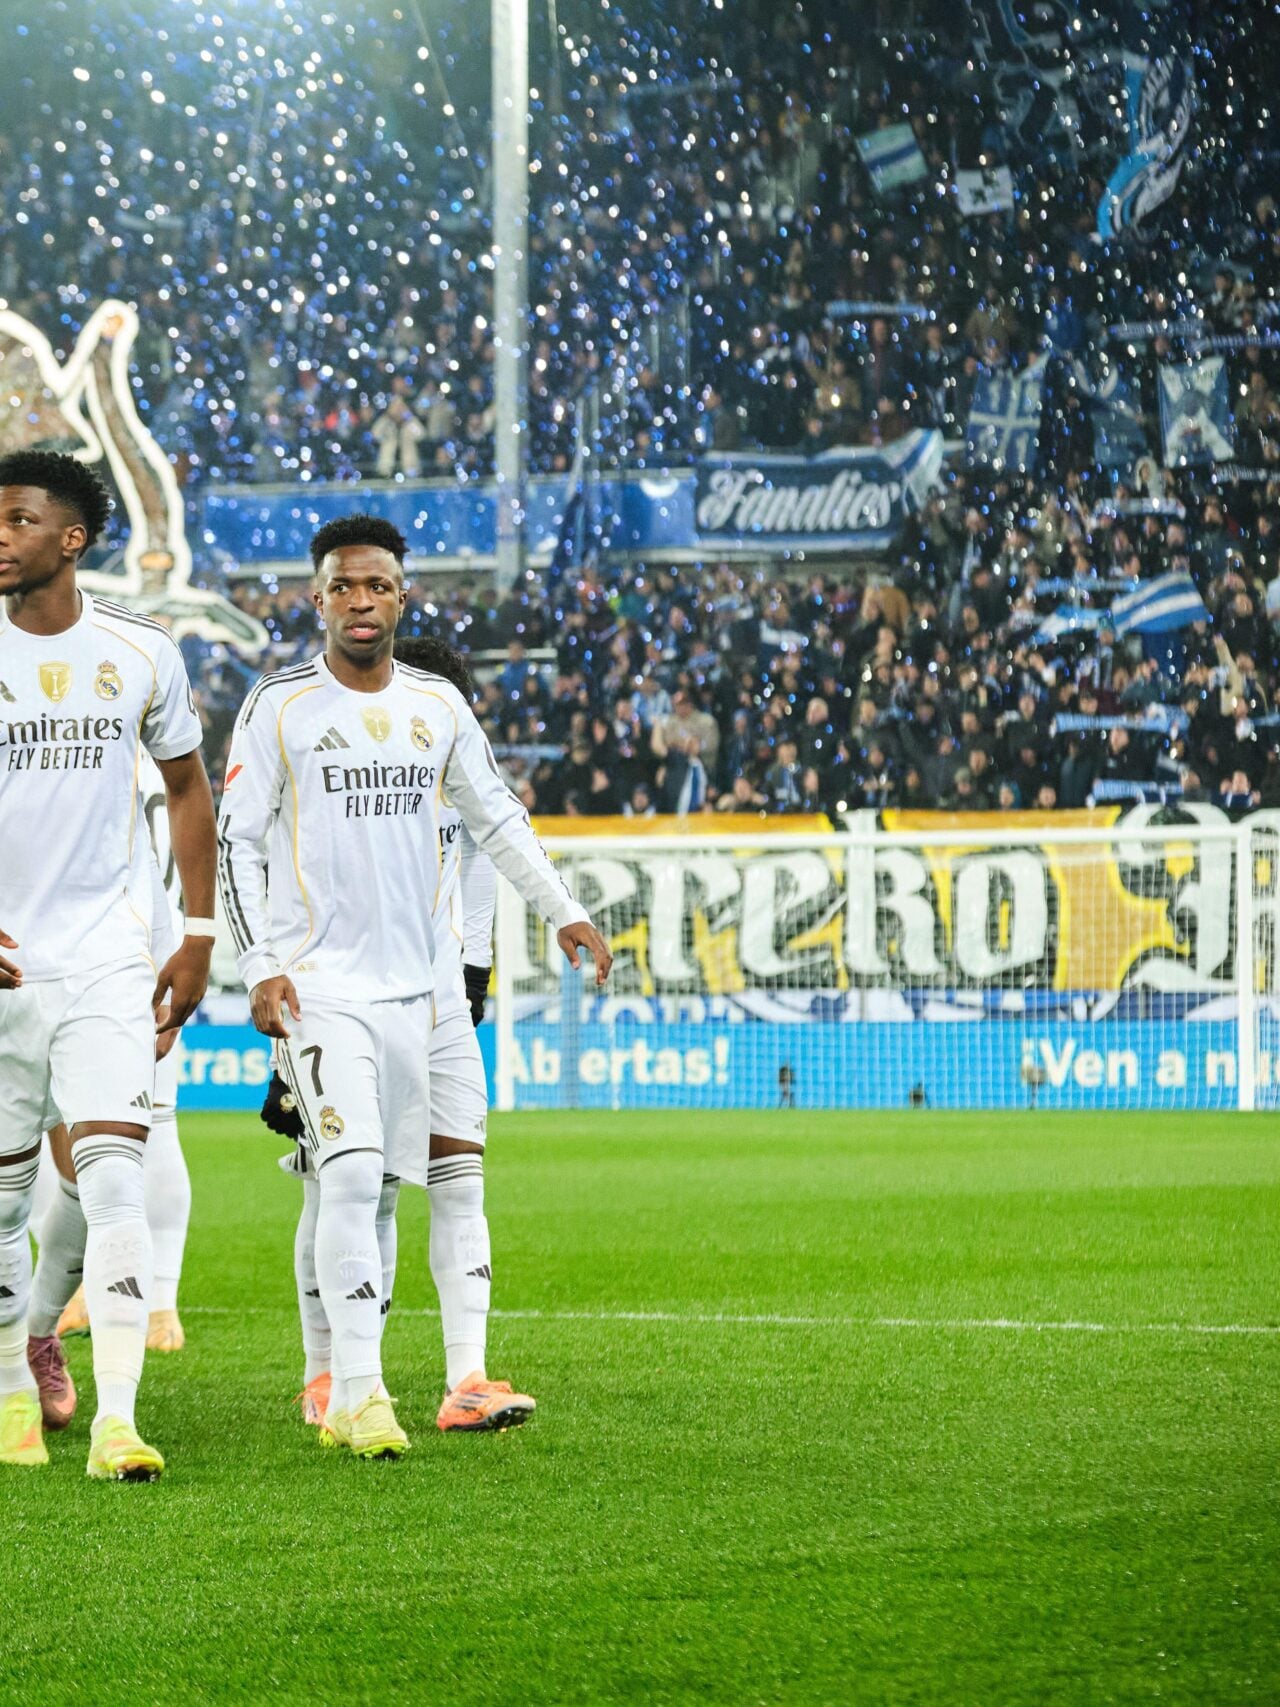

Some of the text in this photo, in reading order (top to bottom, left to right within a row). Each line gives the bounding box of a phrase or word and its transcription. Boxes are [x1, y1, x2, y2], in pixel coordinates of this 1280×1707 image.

[8, 746, 104, 771] FLY BETTER
[322, 760, 435, 793] Emirates
[346, 793, 423, 818] FLY BETTER
[299, 1044, 324, 1097] 7
[495, 1036, 730, 1085] Abertas!
[1156, 1050, 1187, 1088] a
